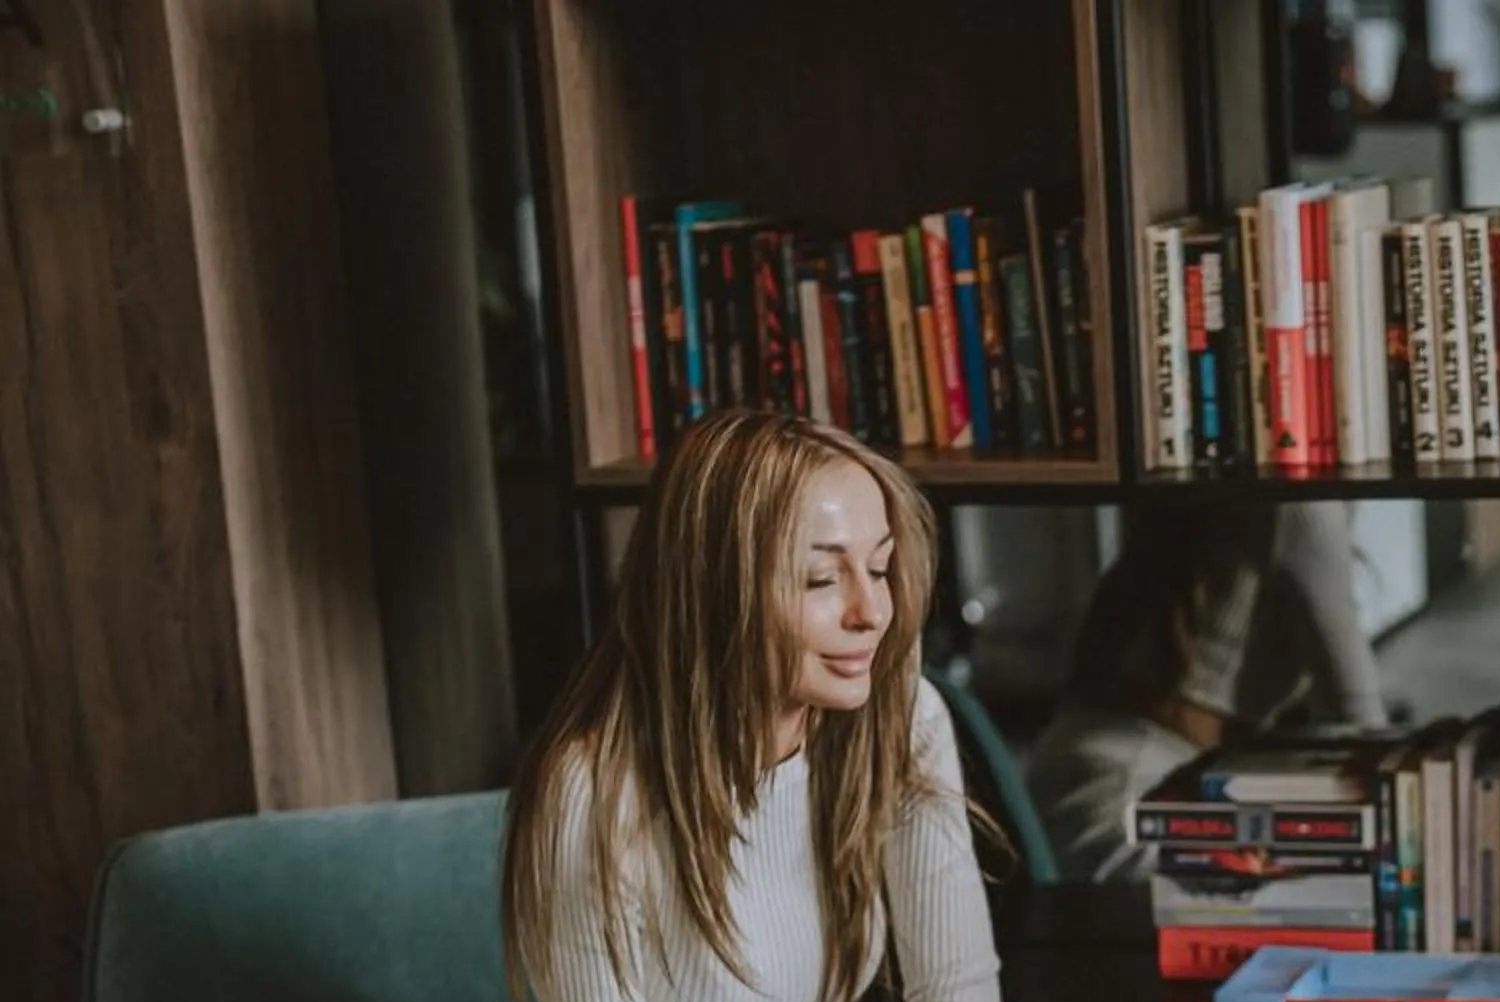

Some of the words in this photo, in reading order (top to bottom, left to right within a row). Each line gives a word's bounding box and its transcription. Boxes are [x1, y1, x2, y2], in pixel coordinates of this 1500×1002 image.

[1155, 241, 1171, 336] HISTORIA
[1408, 236, 1425, 332] HISTORIA
[1439, 237, 1456, 332] HISTORIA
[1467, 228, 1484, 327] HISTORIA
[1158, 345, 1173, 418] SZTUKI
[1414, 342, 1430, 414] SZTUKI
[1443, 342, 1459, 415] SZTUKI
[1473, 333, 1489, 407] SZTUKI
